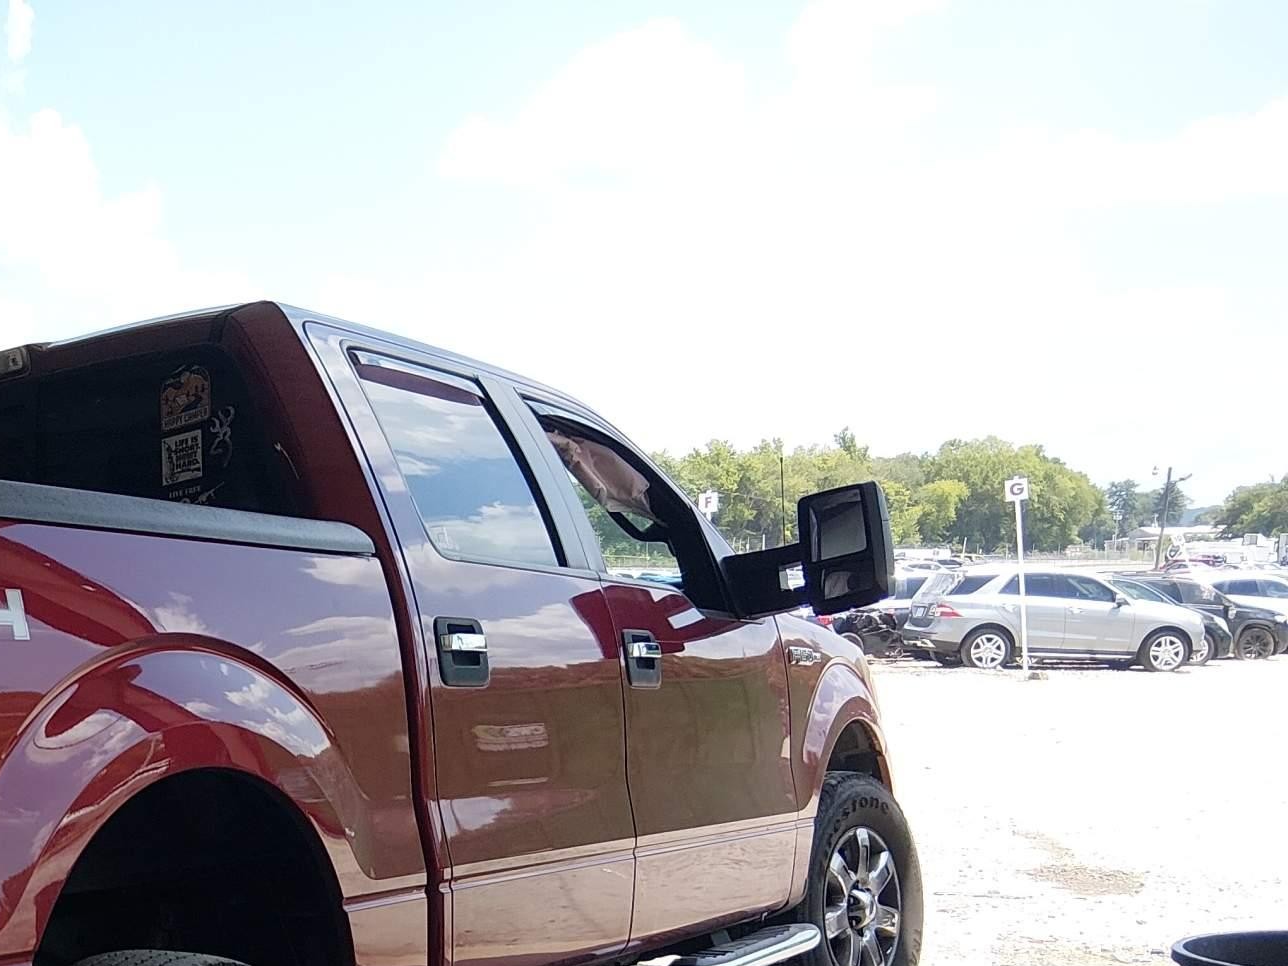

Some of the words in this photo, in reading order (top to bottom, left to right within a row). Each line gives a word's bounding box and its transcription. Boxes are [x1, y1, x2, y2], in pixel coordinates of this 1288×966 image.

[174, 437, 189, 448] LIFE
[190, 435, 199, 445] IS
[1010, 483, 1024, 496] G
[704, 497, 712, 508] F
